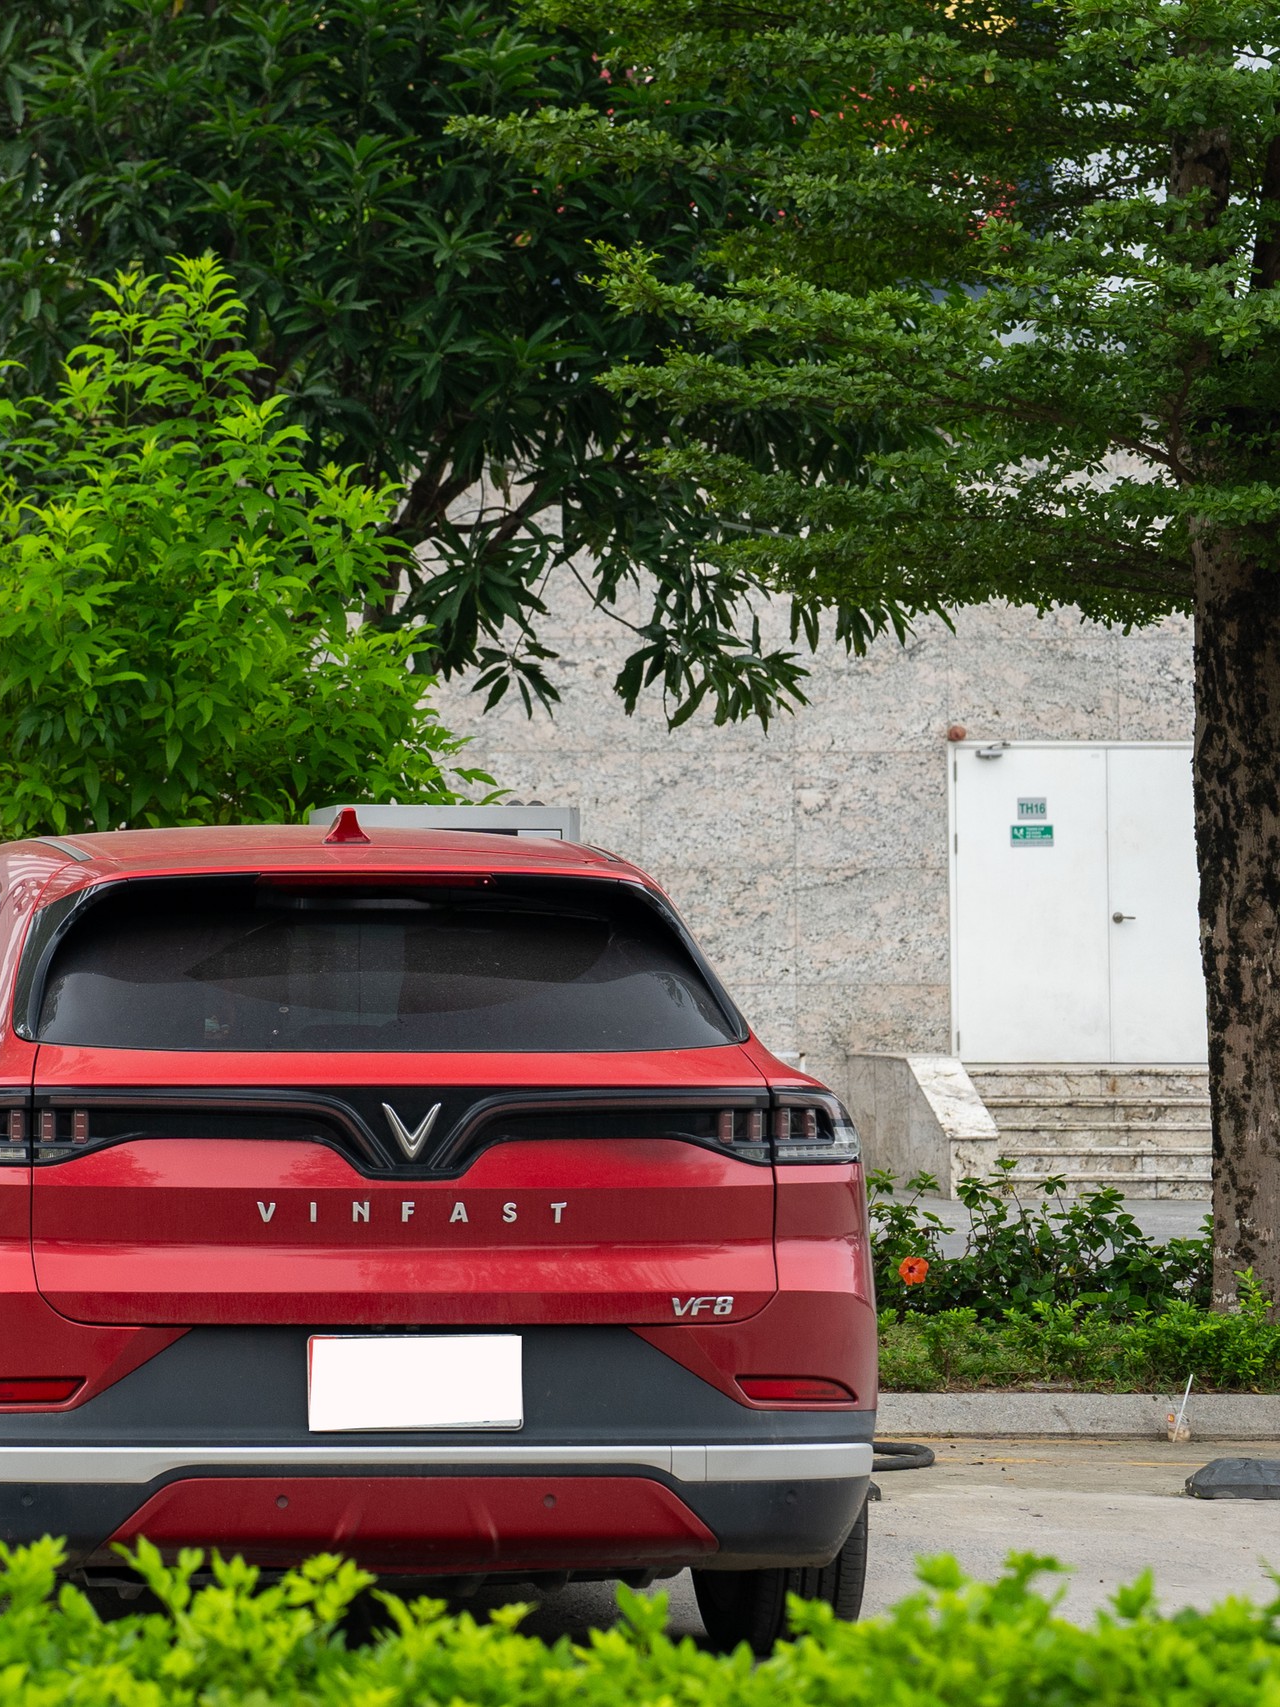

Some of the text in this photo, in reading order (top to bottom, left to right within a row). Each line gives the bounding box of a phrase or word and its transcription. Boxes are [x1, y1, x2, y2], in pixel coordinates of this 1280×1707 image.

[1019, 803, 1046, 814] TH16
[257, 1201, 567, 1224] VINFAST
[672, 1296, 734, 1316] VF8
